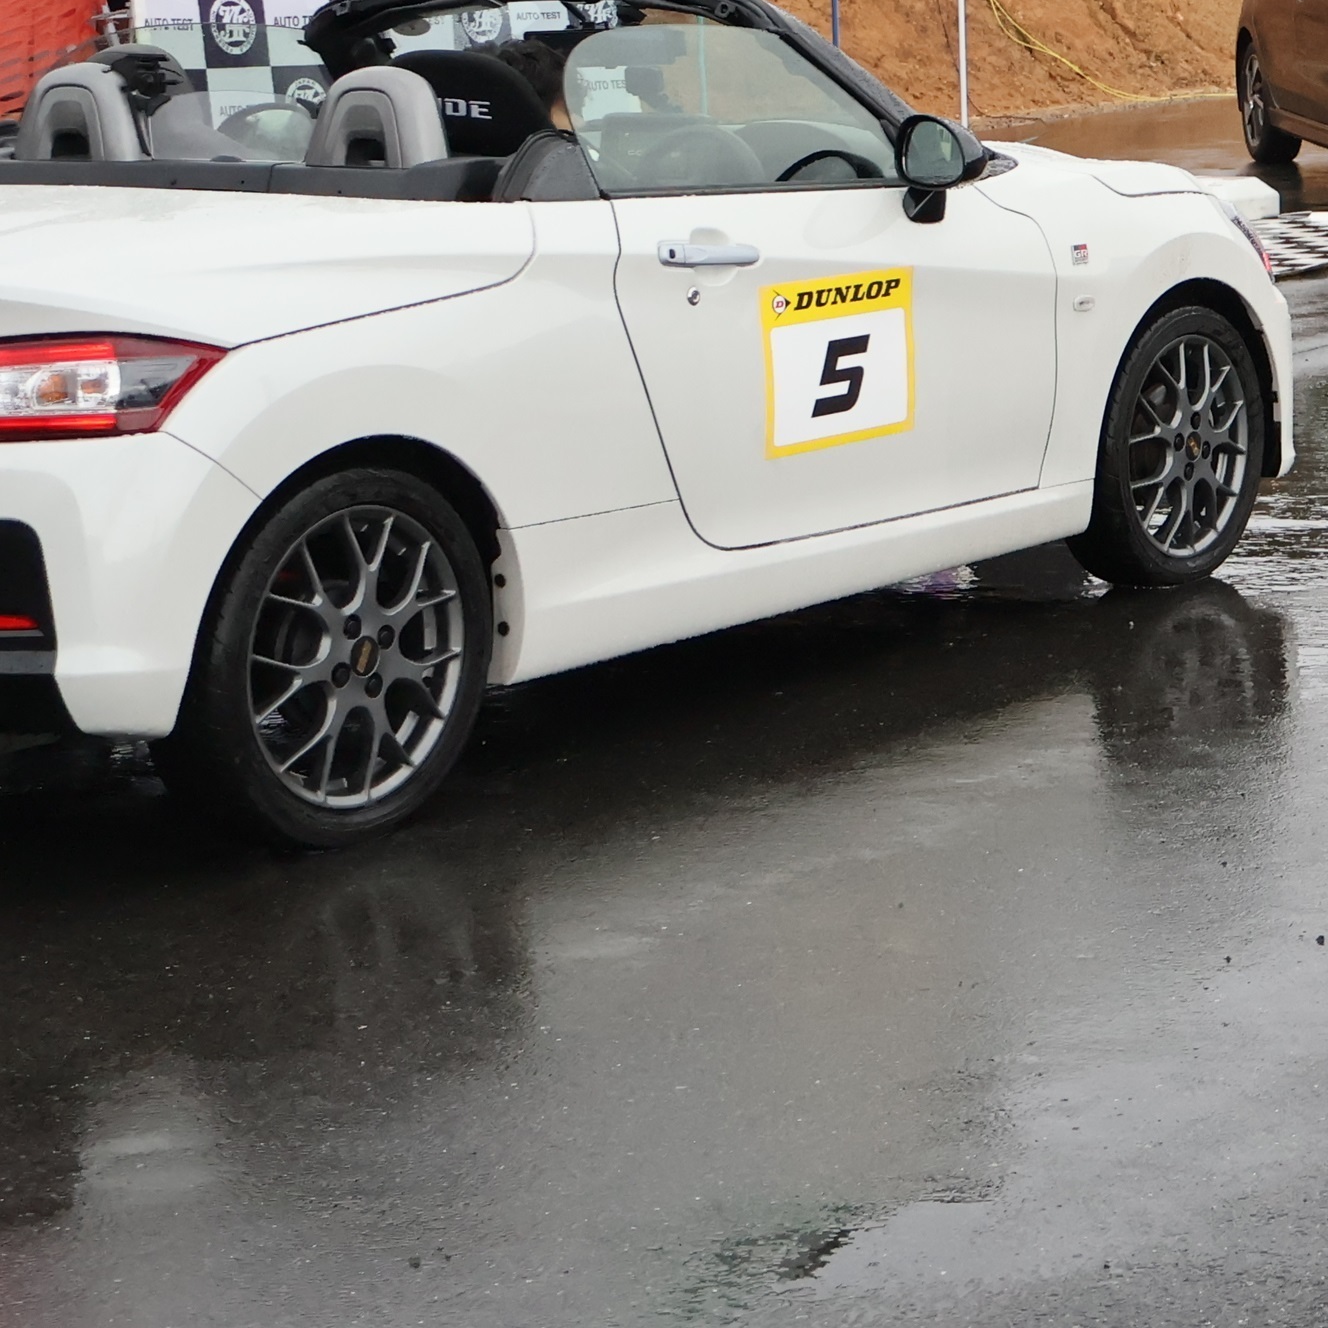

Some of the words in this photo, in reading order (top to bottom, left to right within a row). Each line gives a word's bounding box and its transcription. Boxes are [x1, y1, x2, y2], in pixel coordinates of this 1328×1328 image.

[273, 16, 300, 28] AUTO
[516, 12, 539, 21] AUTO
[541, 11, 561, 20] TEST
[793, 277, 901, 311] DUNLOP
[811, 333, 870, 418] 5
